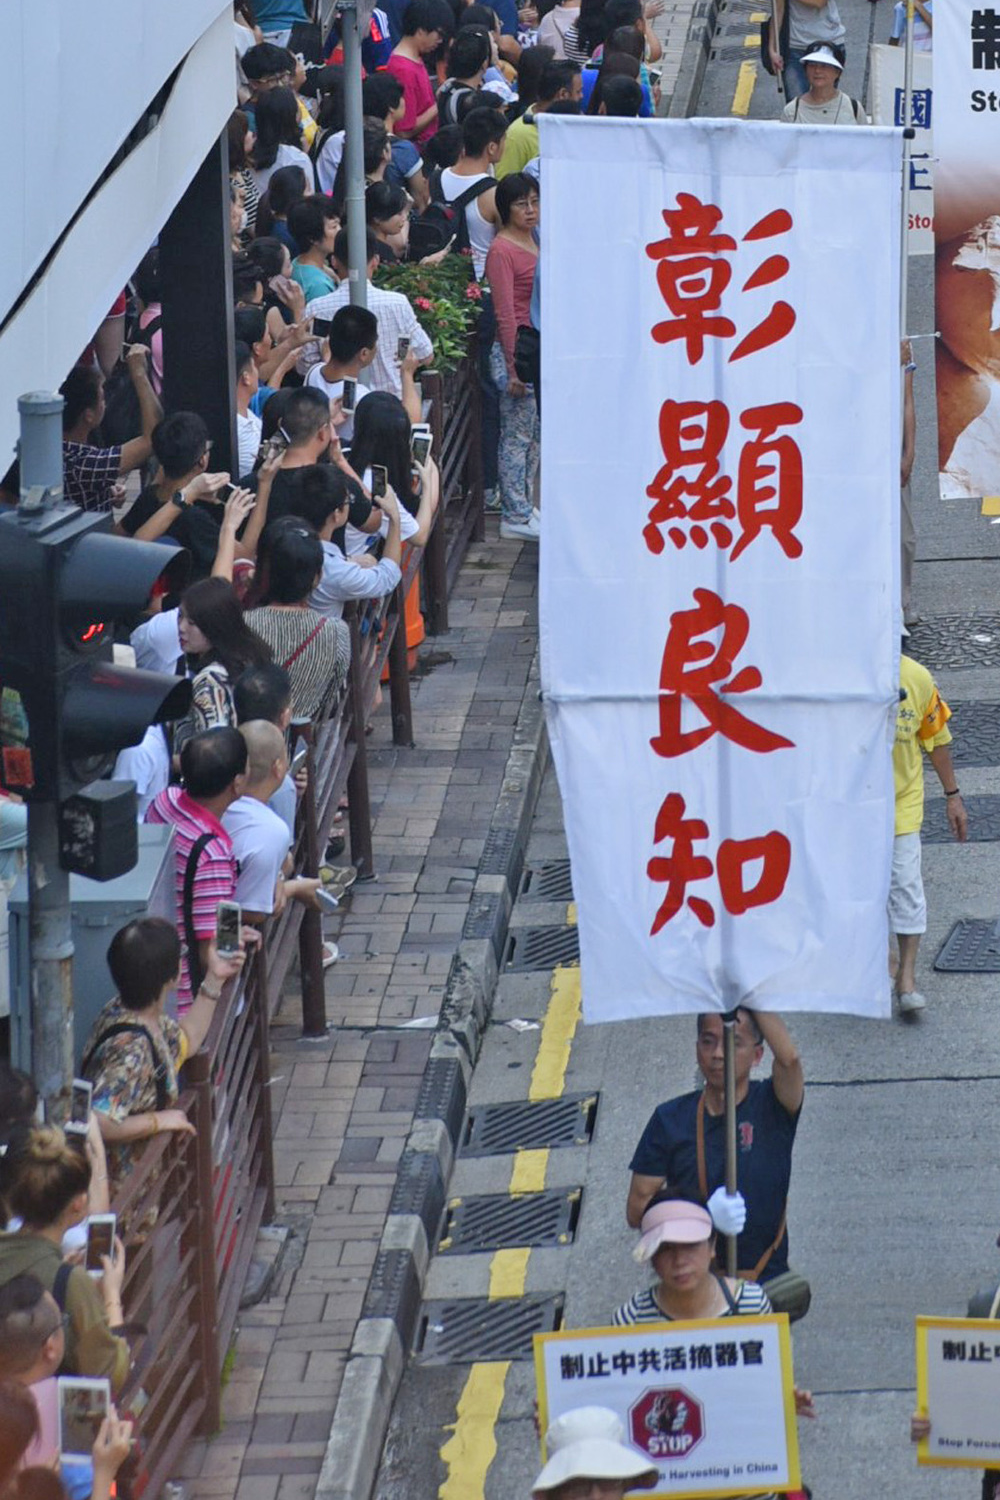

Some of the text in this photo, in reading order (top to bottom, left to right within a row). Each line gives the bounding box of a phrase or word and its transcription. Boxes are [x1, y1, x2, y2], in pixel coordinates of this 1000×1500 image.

[908, 214, 932, 231] Sto
[642, 191, 803, 938] 彰顯良知
[560, 1340, 764, 1380] 制止中共活摘器官
[648, 1433, 693, 1455] STOP
[938, 1437, 963, 1449] Stop
[670, 1466, 731, 1481] Harvesting
[733, 1466, 744, 1474] in
[747, 1462, 779, 1474] China
